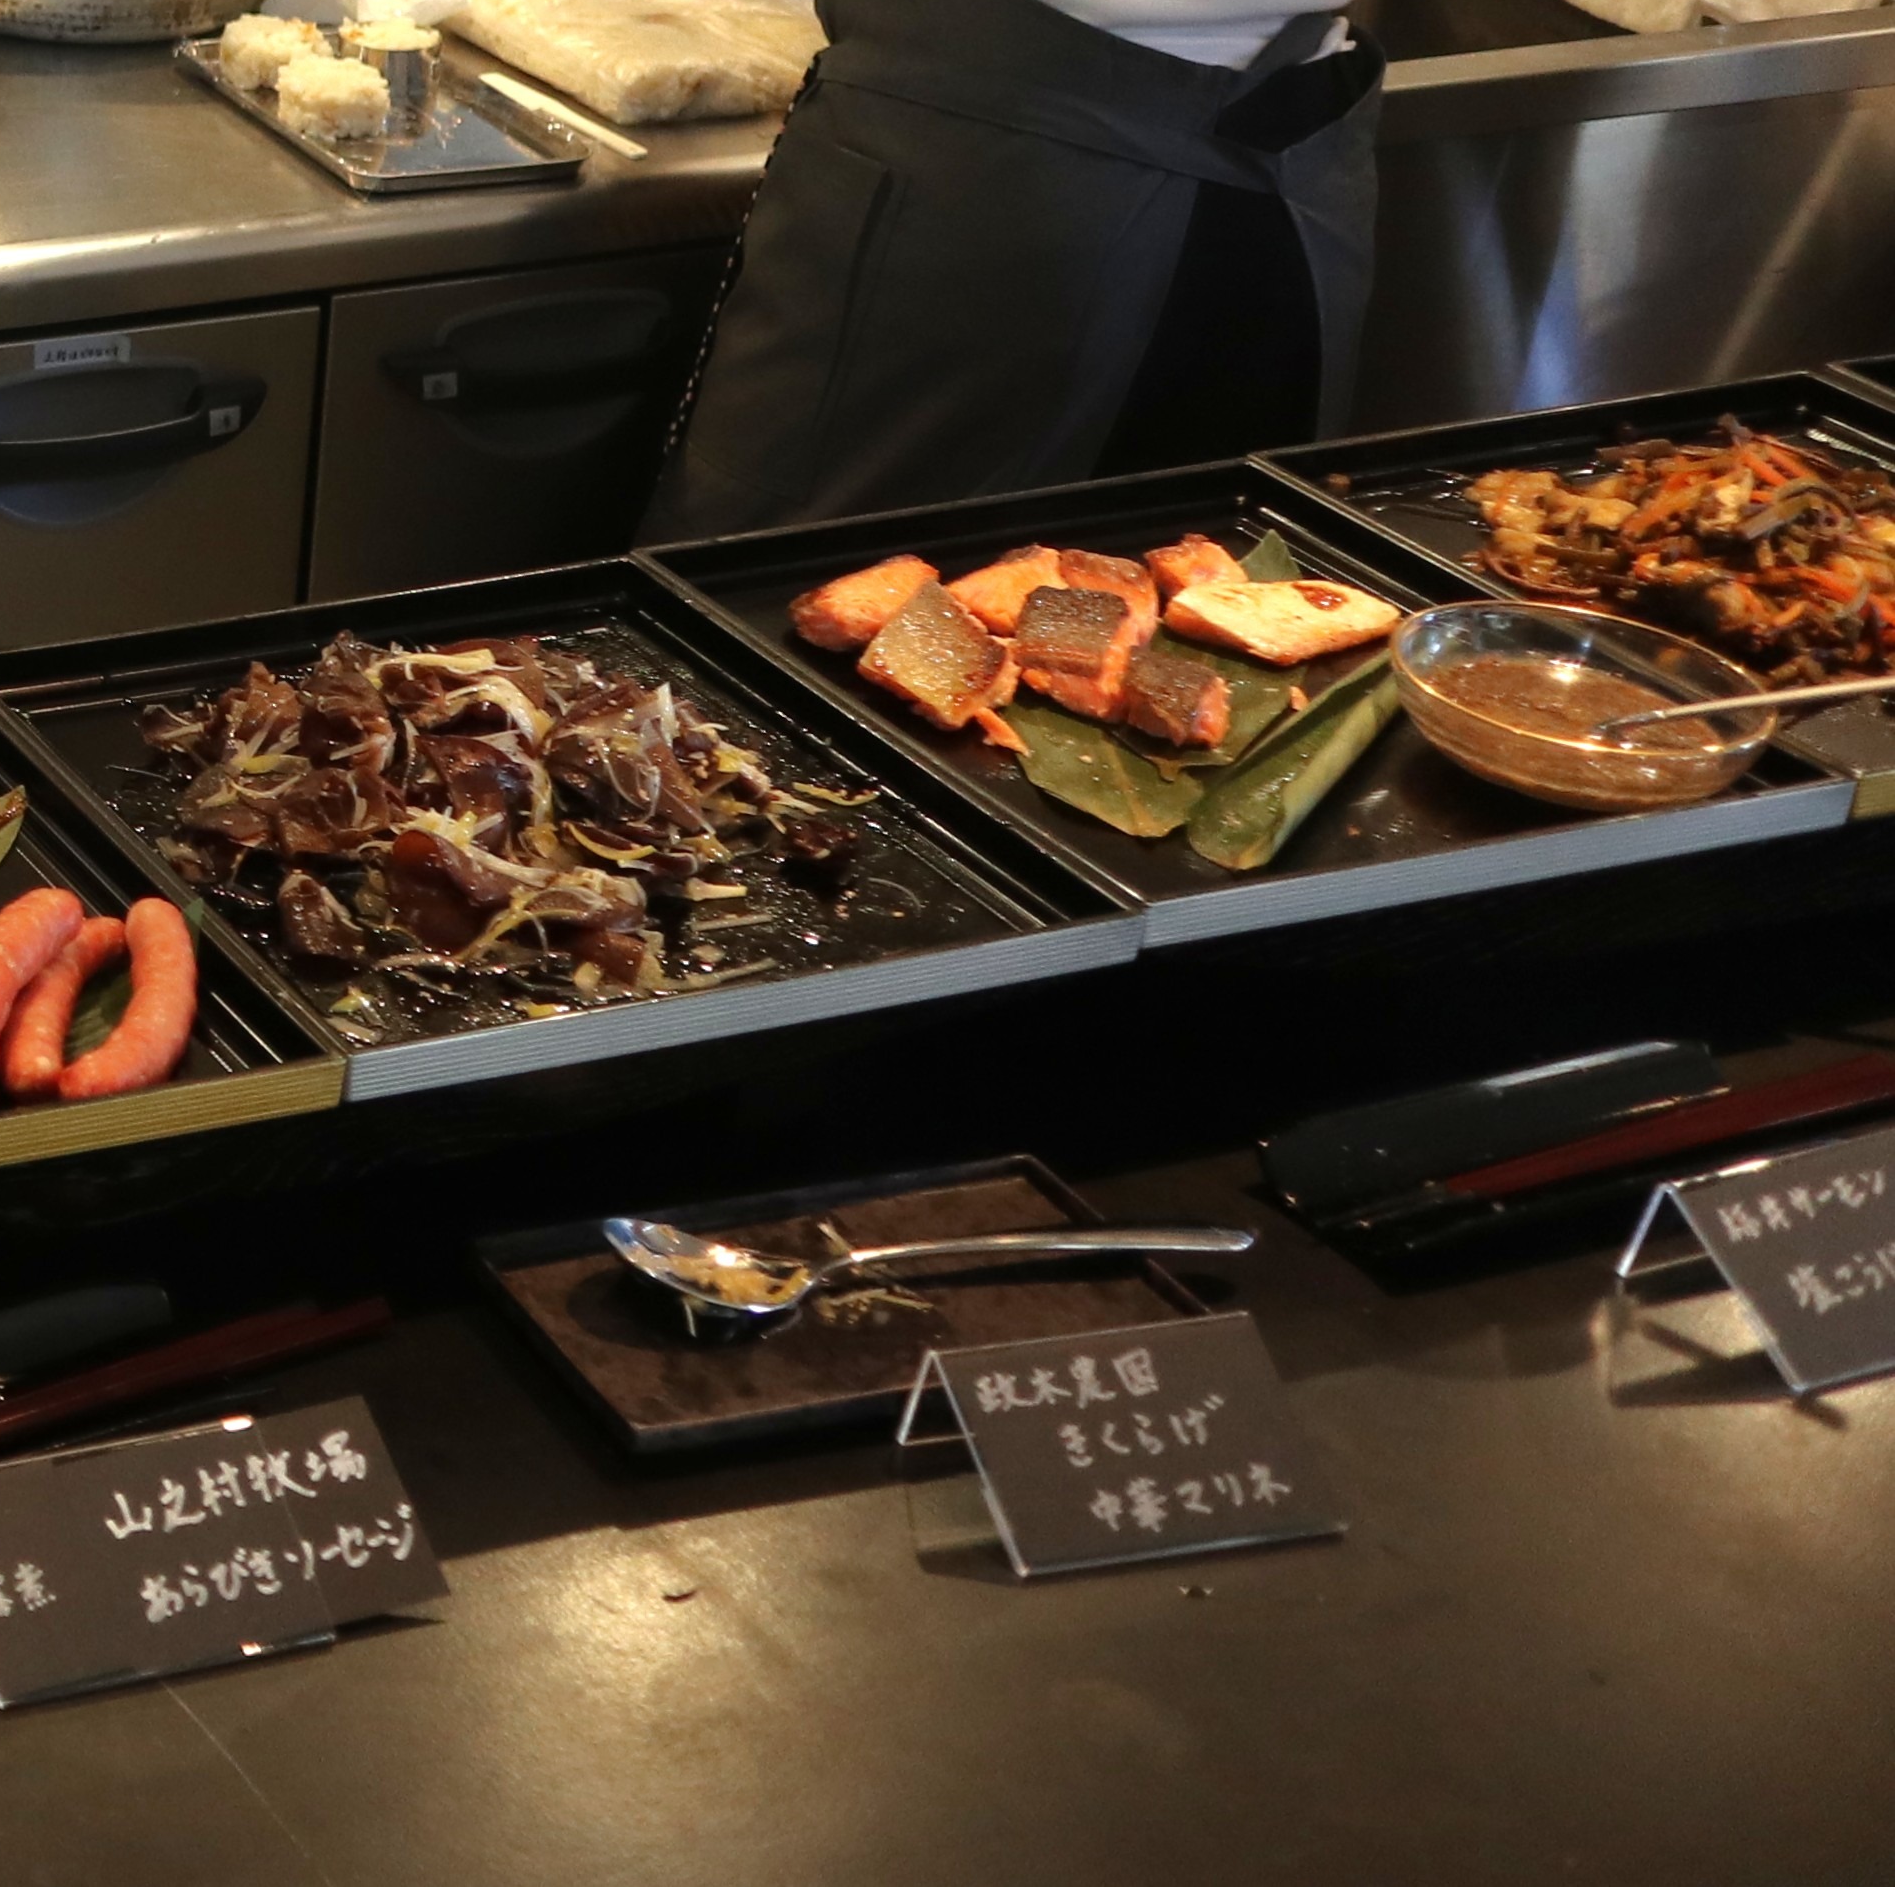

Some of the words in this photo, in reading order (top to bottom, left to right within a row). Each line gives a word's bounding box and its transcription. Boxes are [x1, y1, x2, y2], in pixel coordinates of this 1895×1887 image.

[1058, 1393, 1225, 1468] きくらげ
[105, 1429, 371, 1541] 山之村牧場
[1088, 1461, 1292, 1533] 中華マリネ
[139, 1503, 417, 1625] あらびきソーセージ
